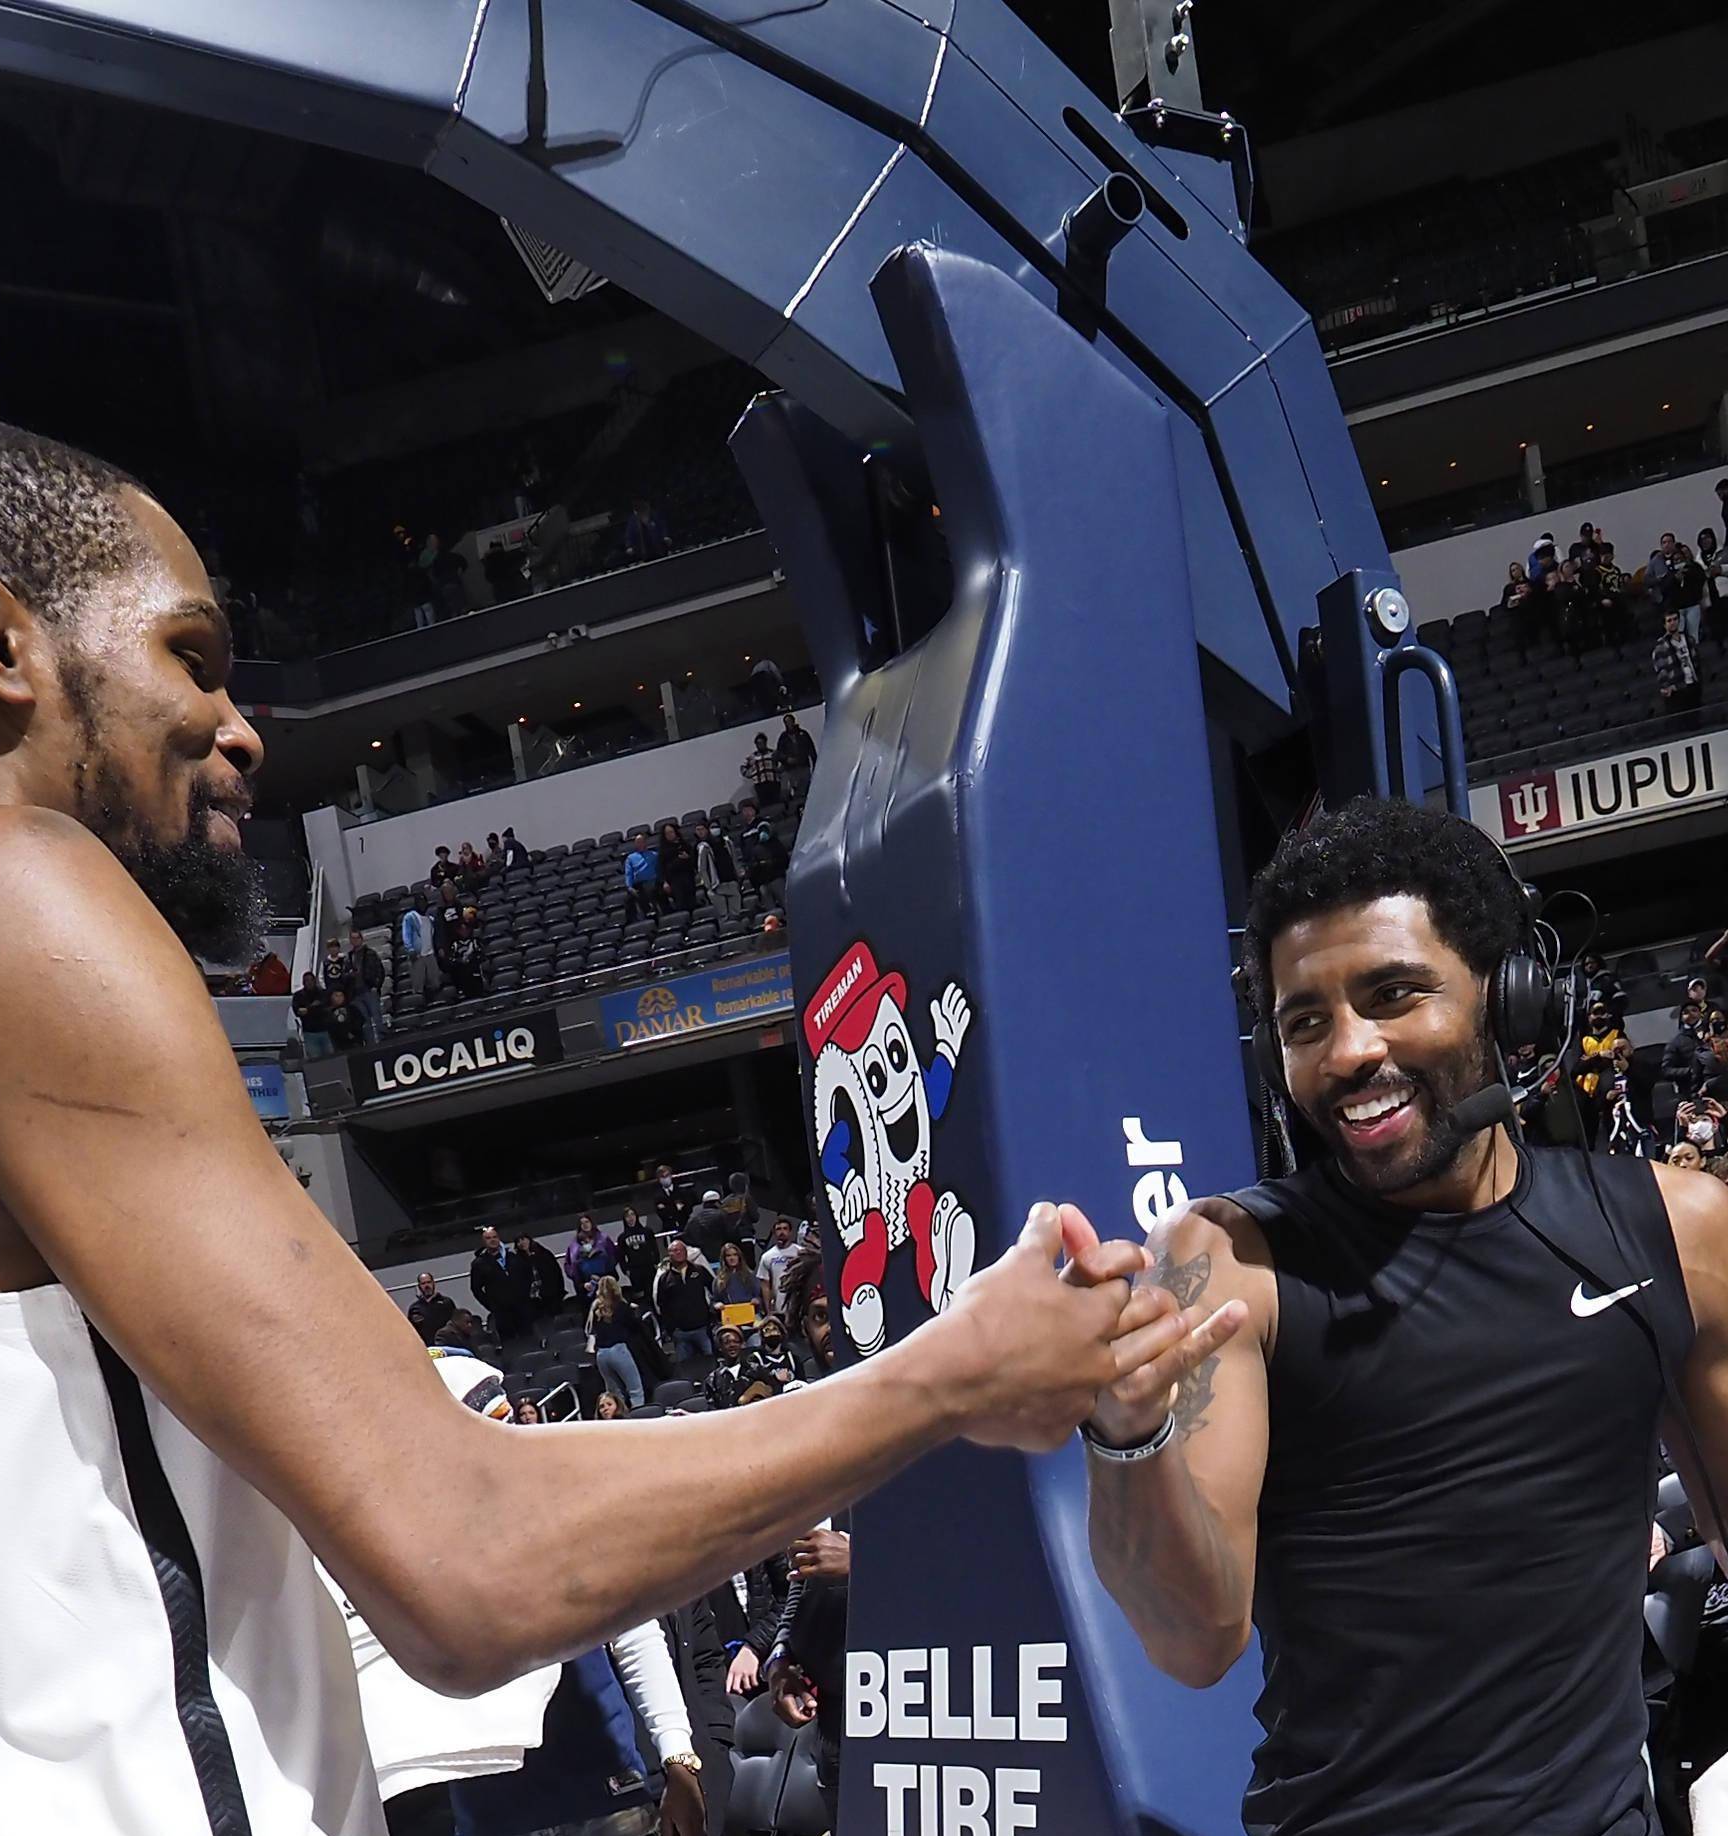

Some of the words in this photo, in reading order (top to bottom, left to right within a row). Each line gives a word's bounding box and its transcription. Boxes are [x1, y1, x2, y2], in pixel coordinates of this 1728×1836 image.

[1570, 742, 1715, 821] IUPUI
[613, 1002, 705, 1044] DAMAR
[716, 990, 781, 1016] Remarkable
[813, 956, 866, 1031] TIREMAN
[373, 1026, 536, 1093] LOCALiQ
[845, 1643, 1068, 1741] BELLE
